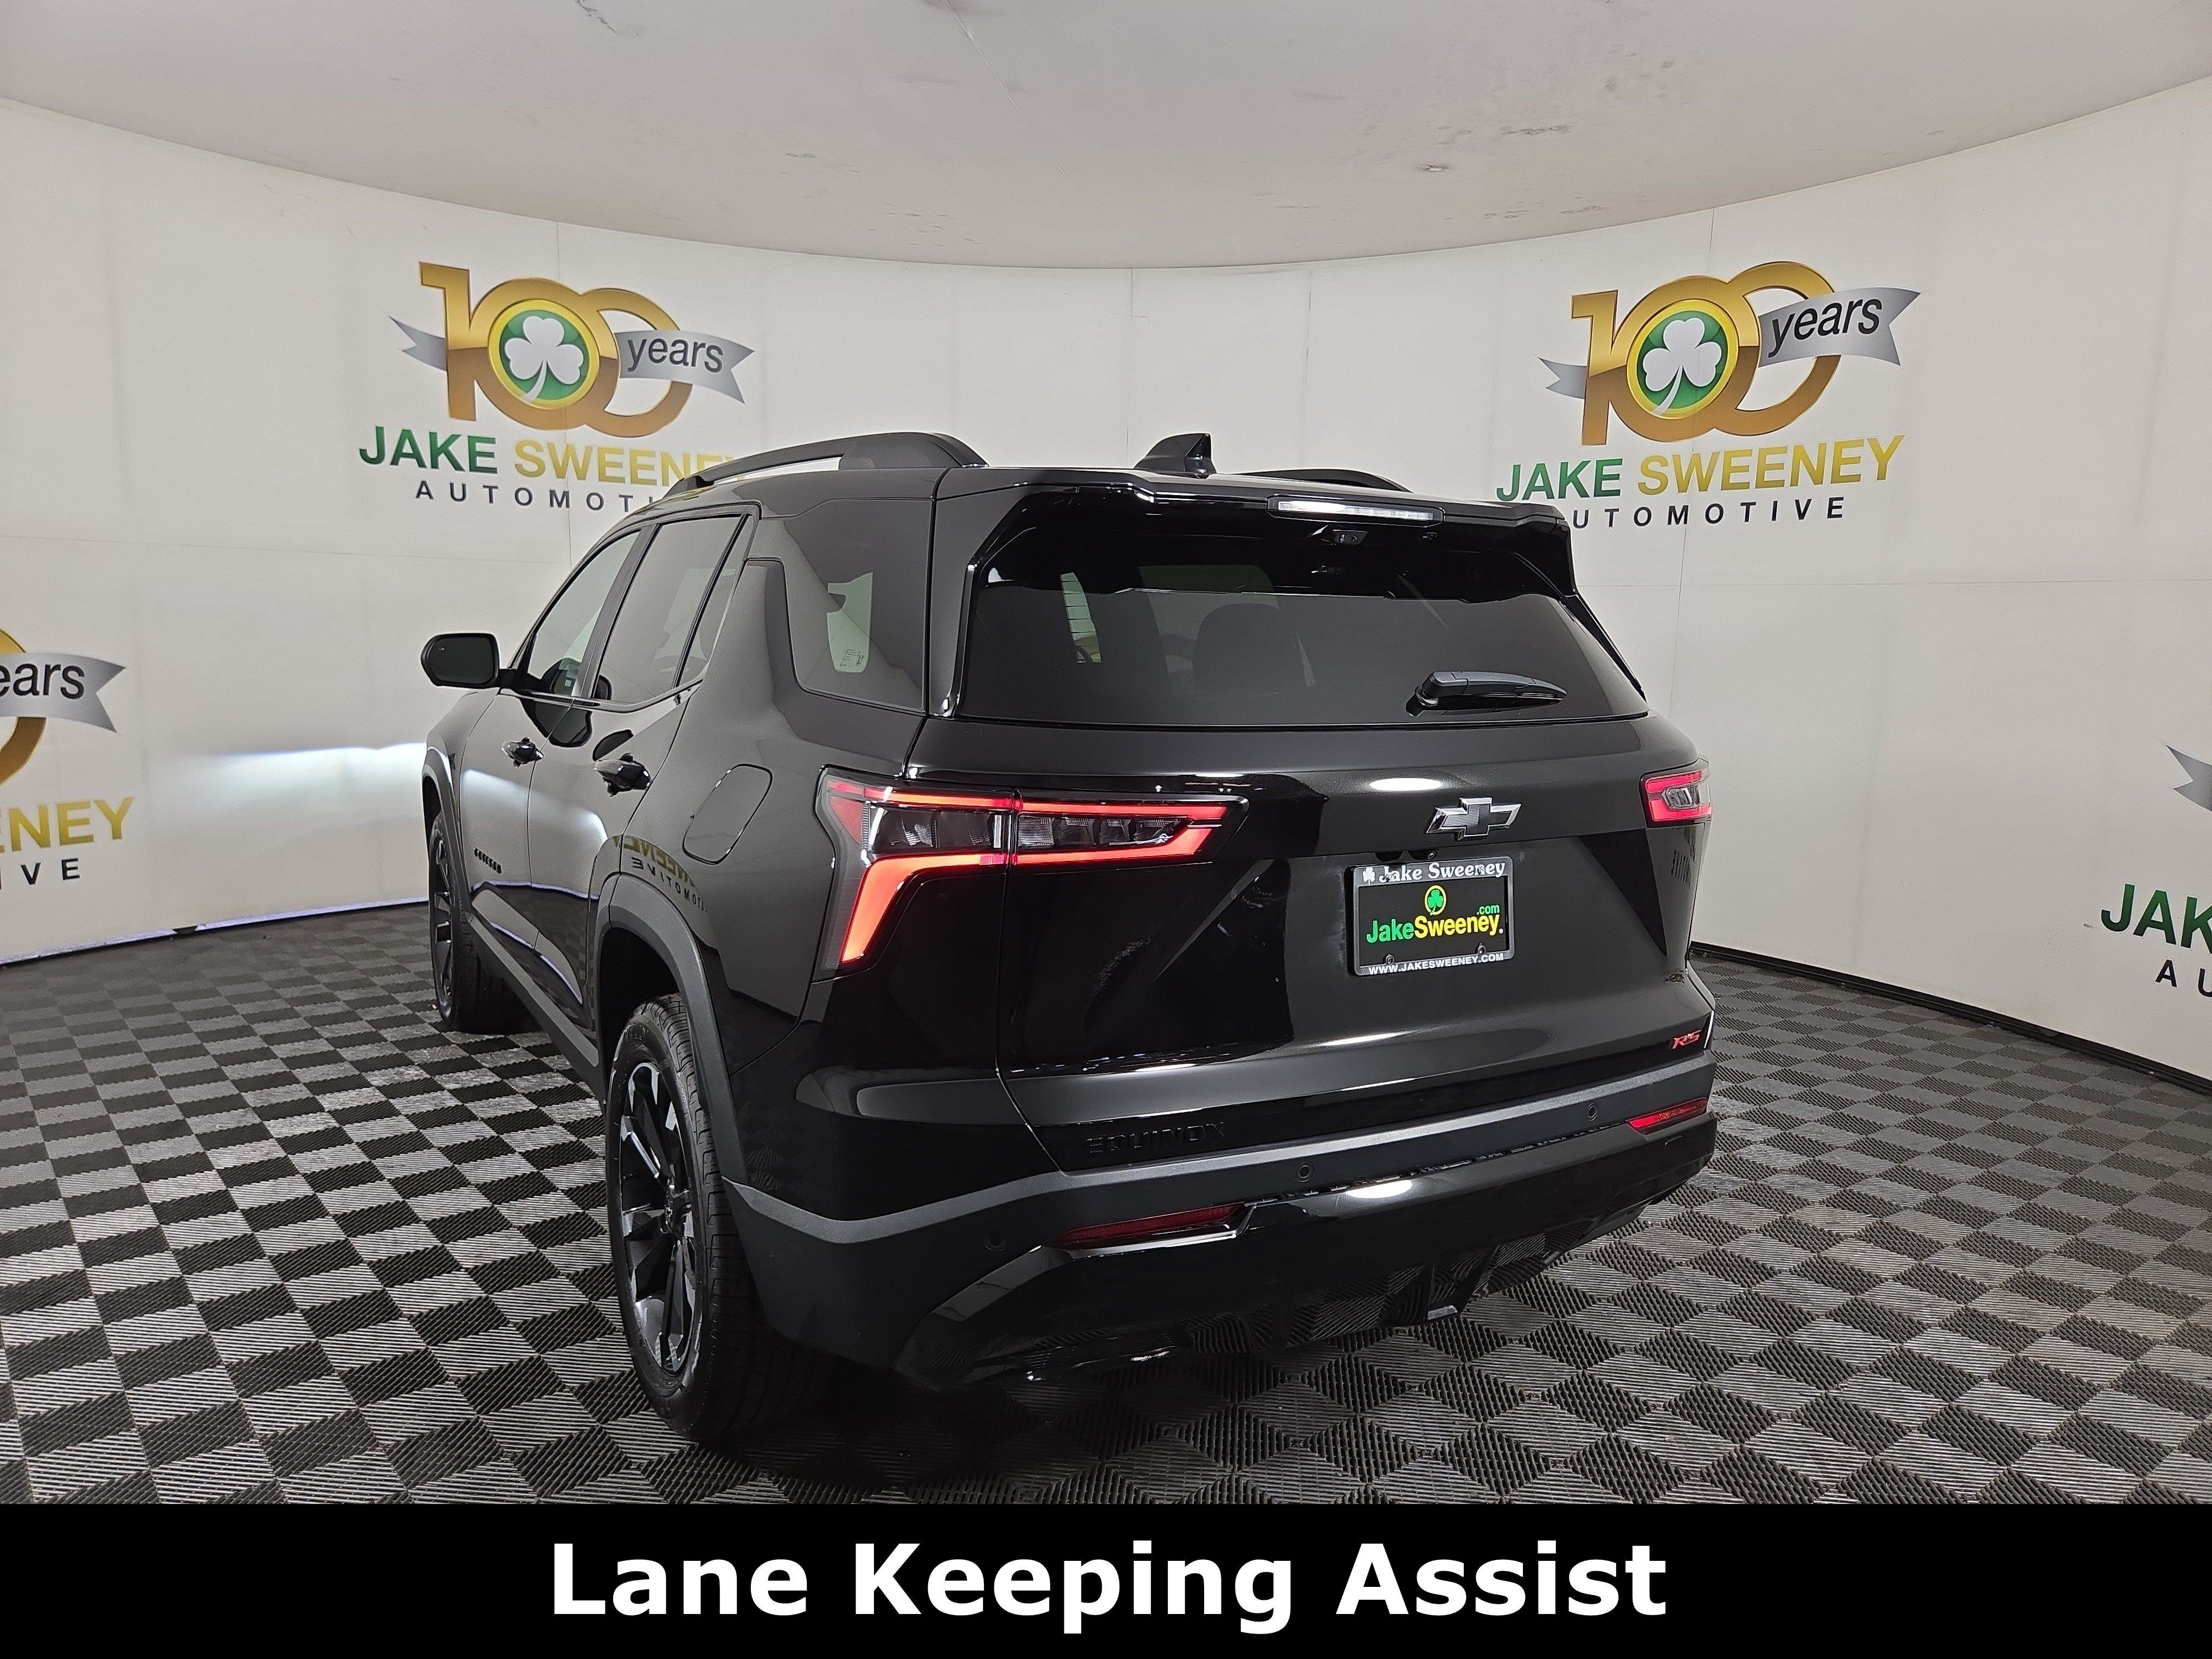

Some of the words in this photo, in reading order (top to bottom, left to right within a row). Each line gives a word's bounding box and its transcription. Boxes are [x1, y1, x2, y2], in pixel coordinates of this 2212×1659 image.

[1767, 297, 1883, 358] years
[626, 331, 724, 374] years
[358, 426, 499, 475] JAKE
[515, 439, 736, 487] SWEEN
[1496, 458, 1624, 501] JAKE
[1637, 434, 1906, 496] SWEENEY
[1573, 496, 1845, 529] UTOMOTIVE
[0, 796, 134, 854] NEY
[1379, 865, 1423, 883] Jake
[1427, 863, 1506, 878] Sweeney
[1368, 953, 1504, 975] WWW.JAKESWEENEY.COM
[1671, 1030, 1702, 1049] RS
[1085, 1121, 1227, 1154] EQUINOX
